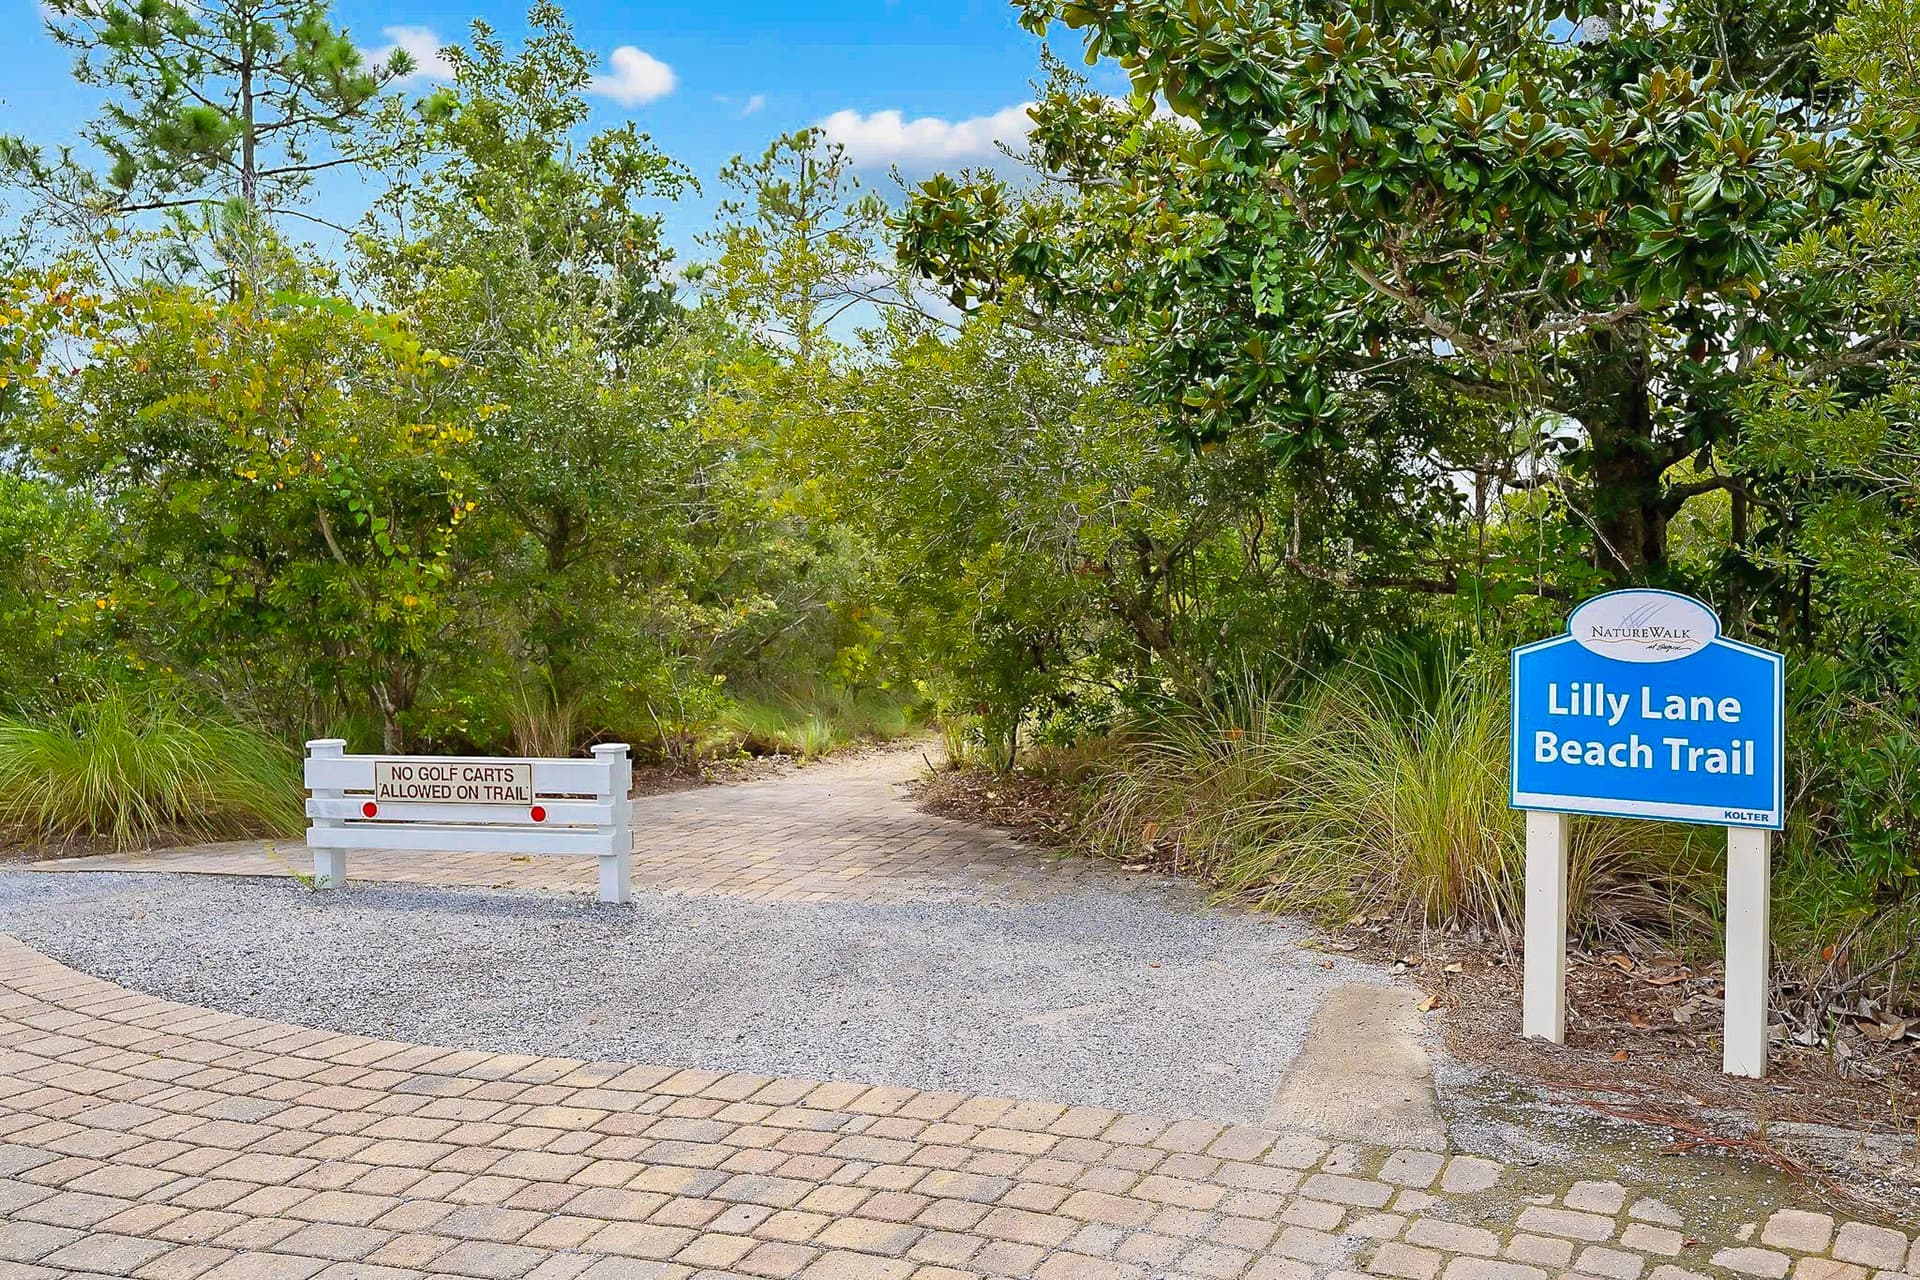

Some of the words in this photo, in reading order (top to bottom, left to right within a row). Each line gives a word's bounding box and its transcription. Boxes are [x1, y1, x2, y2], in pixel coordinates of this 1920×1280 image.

[1548, 682, 1630, 726] Lilly
[1641, 686, 1741, 723] Lane
[1535, 730, 1653, 769] Beach
[1663, 737, 1754, 775] Trail
[391, 766, 413, 781] NO
[418, 767, 458, 781] GOLF
[463, 768, 514, 783] CARTS
[380, 783, 451, 799] ALLOWED
[457, 785, 479, 799] ON
[484, 785, 529, 800] TRAIL
[1724, 810, 1769, 822] KOLTER
